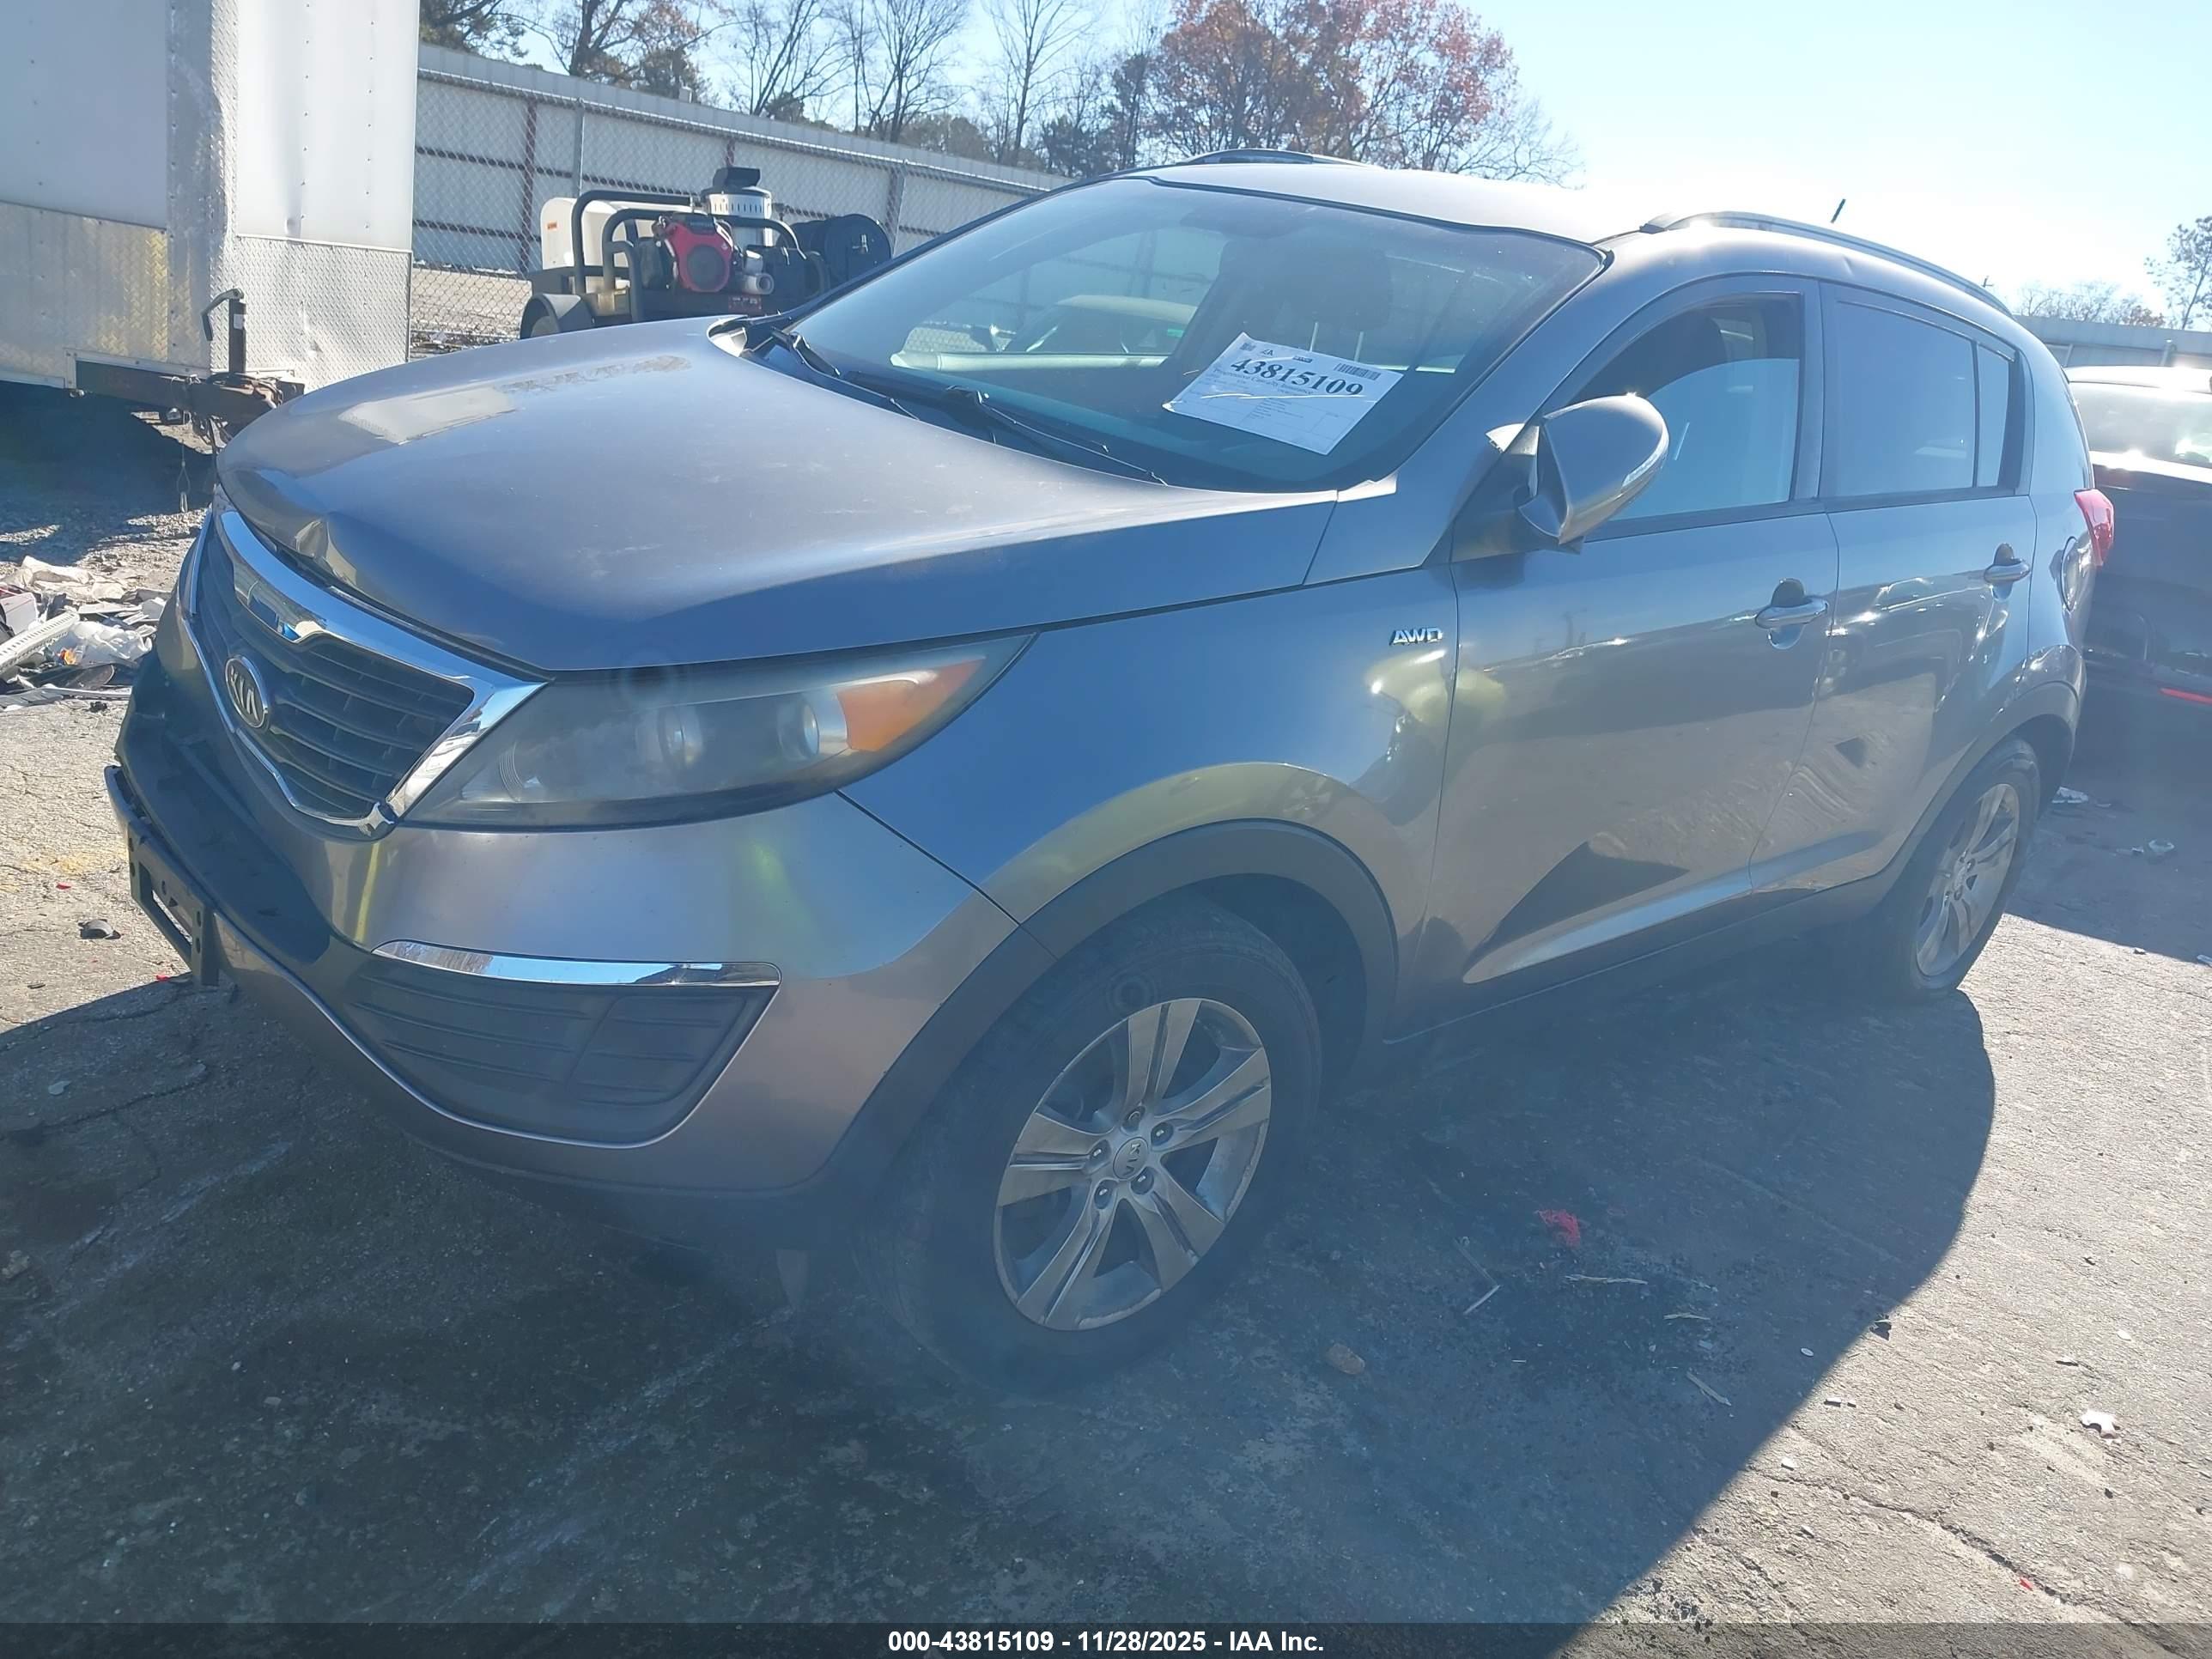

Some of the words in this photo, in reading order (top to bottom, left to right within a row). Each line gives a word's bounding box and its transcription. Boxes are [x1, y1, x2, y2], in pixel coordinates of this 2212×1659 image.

[1230, 357, 1364, 396] 43815109
[1389, 627, 1443, 646] AWD
[229, 664, 260, 721] KIA
